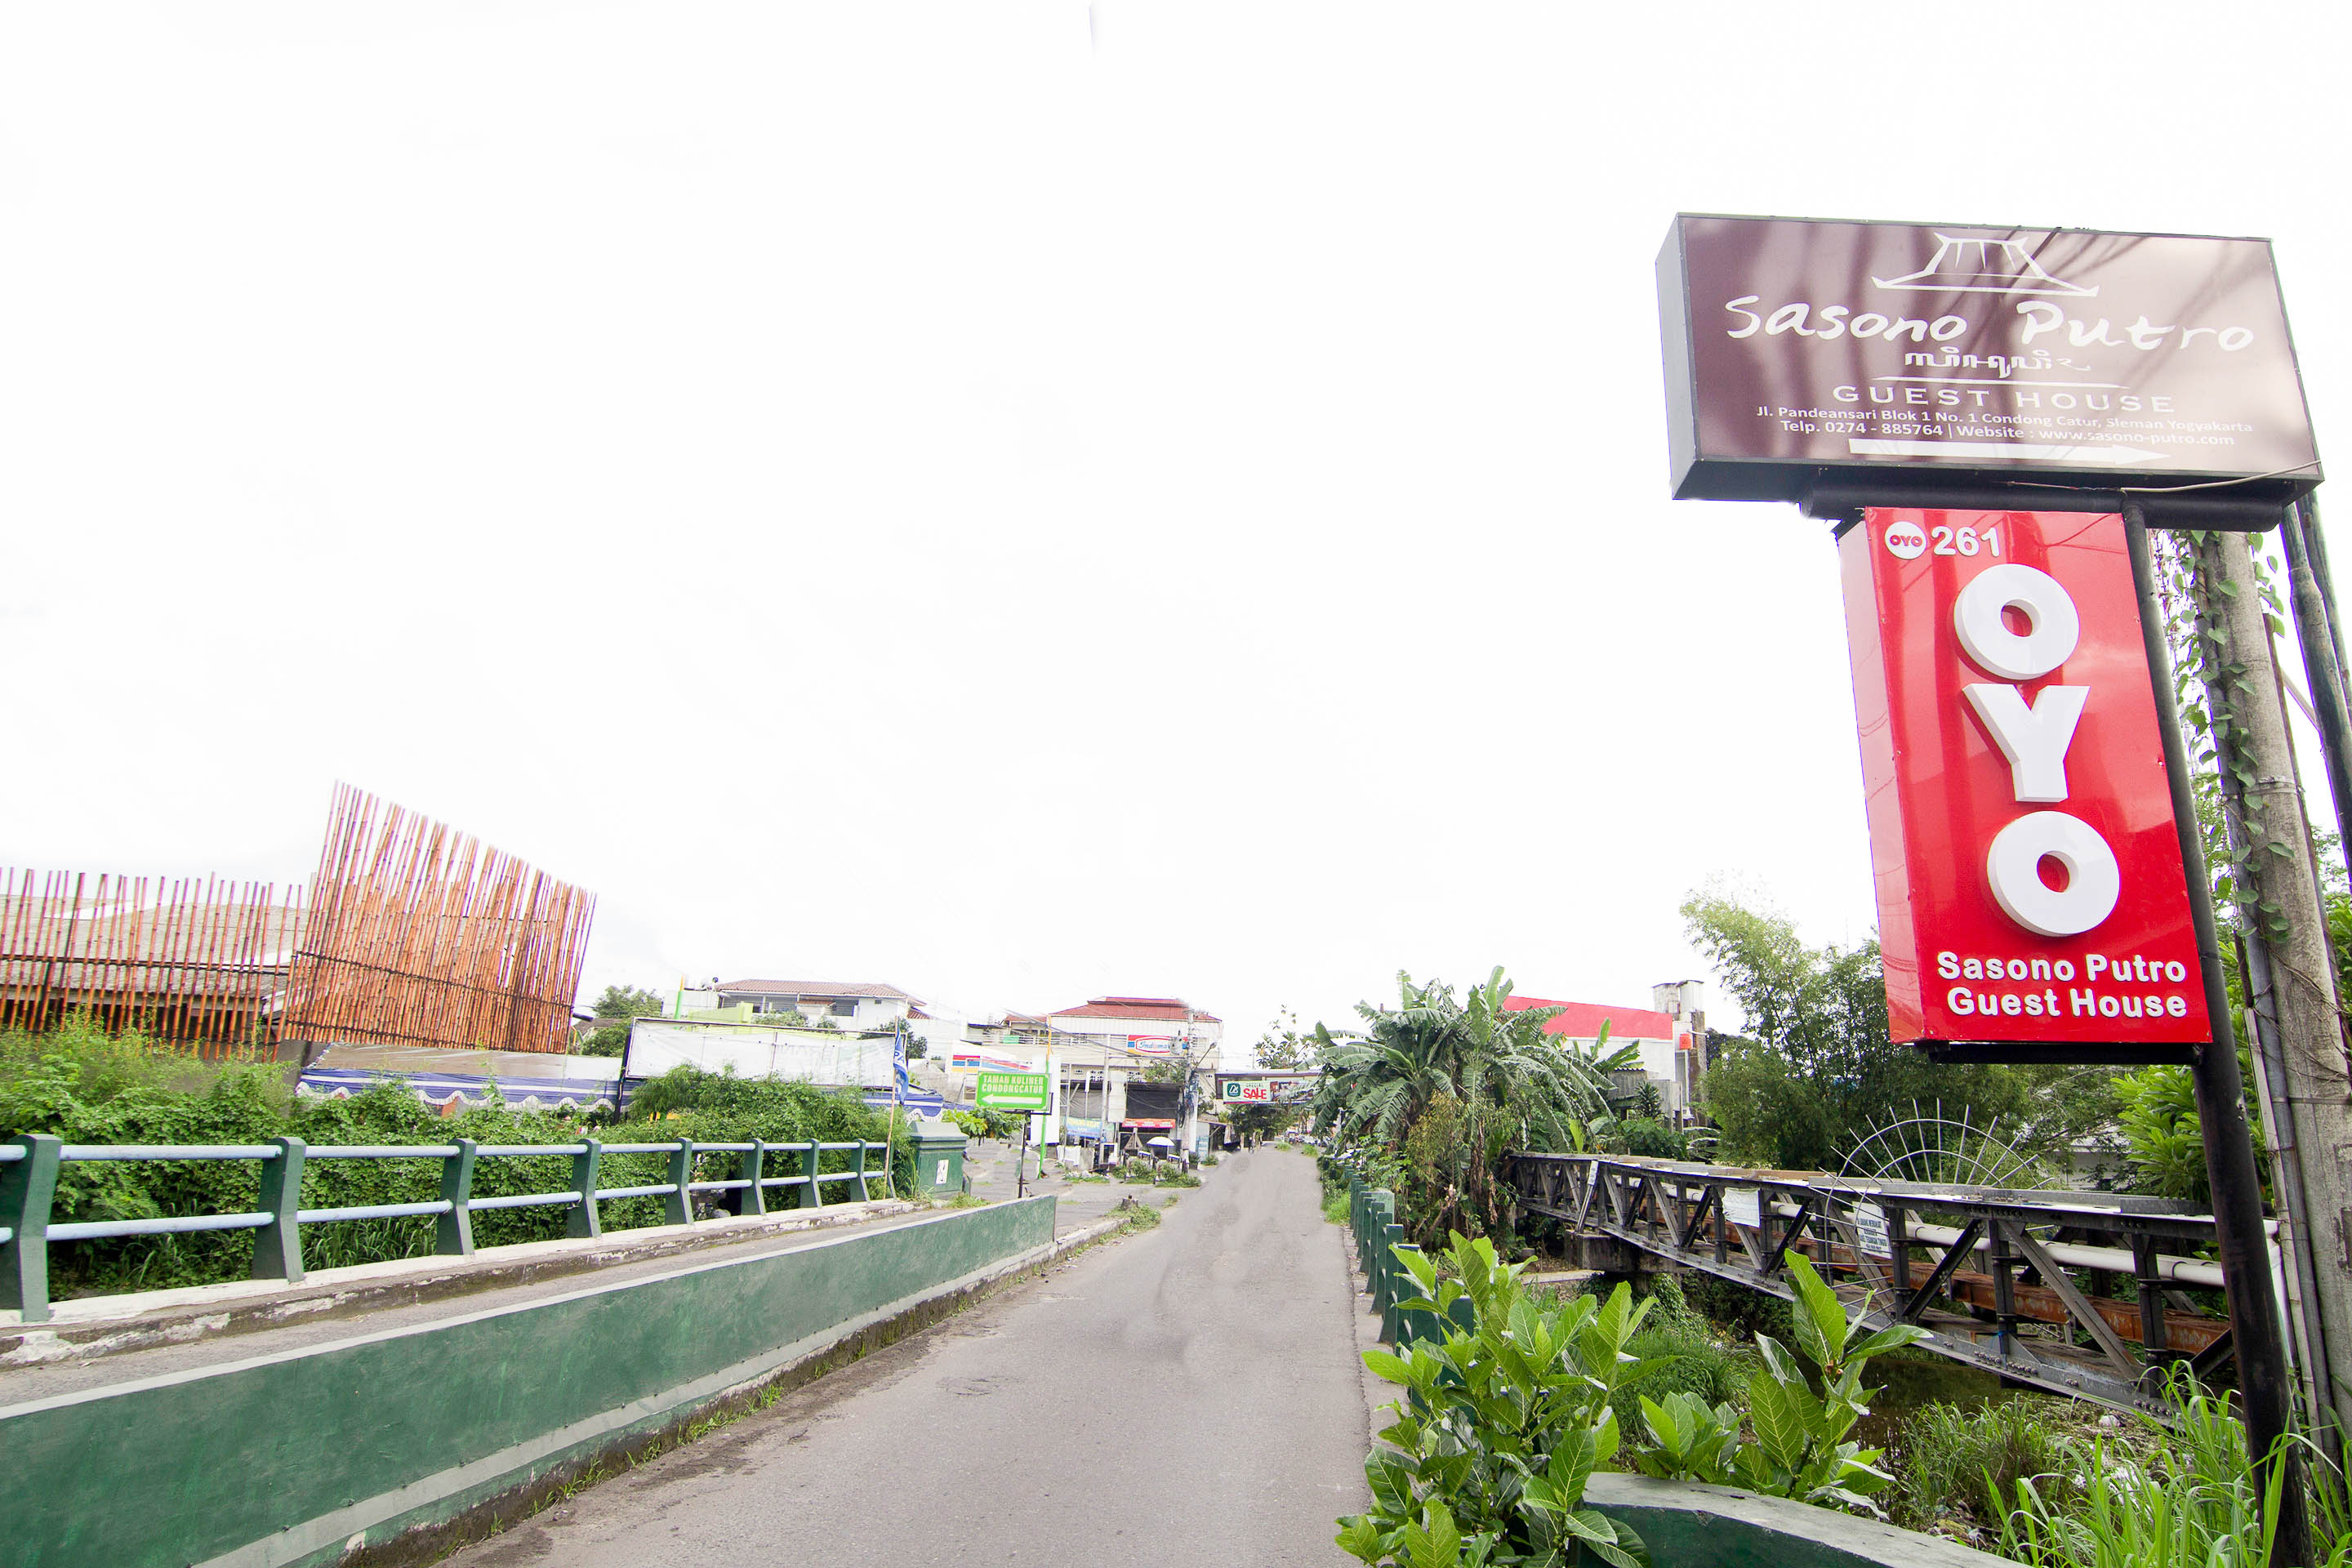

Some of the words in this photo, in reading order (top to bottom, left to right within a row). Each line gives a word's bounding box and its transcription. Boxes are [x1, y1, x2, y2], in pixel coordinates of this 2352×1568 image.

[1725, 295, 1967, 341] Sasono
[2016, 301, 2254, 351] Putro
[1833, 385, 1989, 407] GUEST
[2016, 391, 2175, 412] HOUSE
[1779, 407, 1877, 420] Pandeansari
[1882, 410, 1917, 421] Blok
[1922, 412, 1931, 421] 1
[1936, 412, 1962, 422] No.
[1969, 413, 1977, 423] 1
[1982, 413, 2052, 427] Condong
[2056, 416, 2101, 429] Catur,
[2106, 417, 2163, 430] Sleman
[2167, 419, 2253, 433] Yogyakarta
[1780, 421, 1820, 434] Telp.
[1825, 421, 1867, 434] 0274
[1882, 424, 1943, 436] 885764
[1957, 425, 2024, 439] Website
[2038, 429, 2235, 446] www.sasono-putro.com
[1889, 534, 1923, 547] OYO
[1931, 525, 2000, 557] 261
[1937, 951, 2075, 981] Sasono
[2085, 953, 2187, 983] Putro
[1947, 987, 2061, 1017] Guest
[2069, 988, 2188, 1018] House
[983, 1075, 1009, 1085] TAMAN
[1011, 1076, 1044, 1085] KULINER
[1243, 1087, 1267, 1099] SALE
